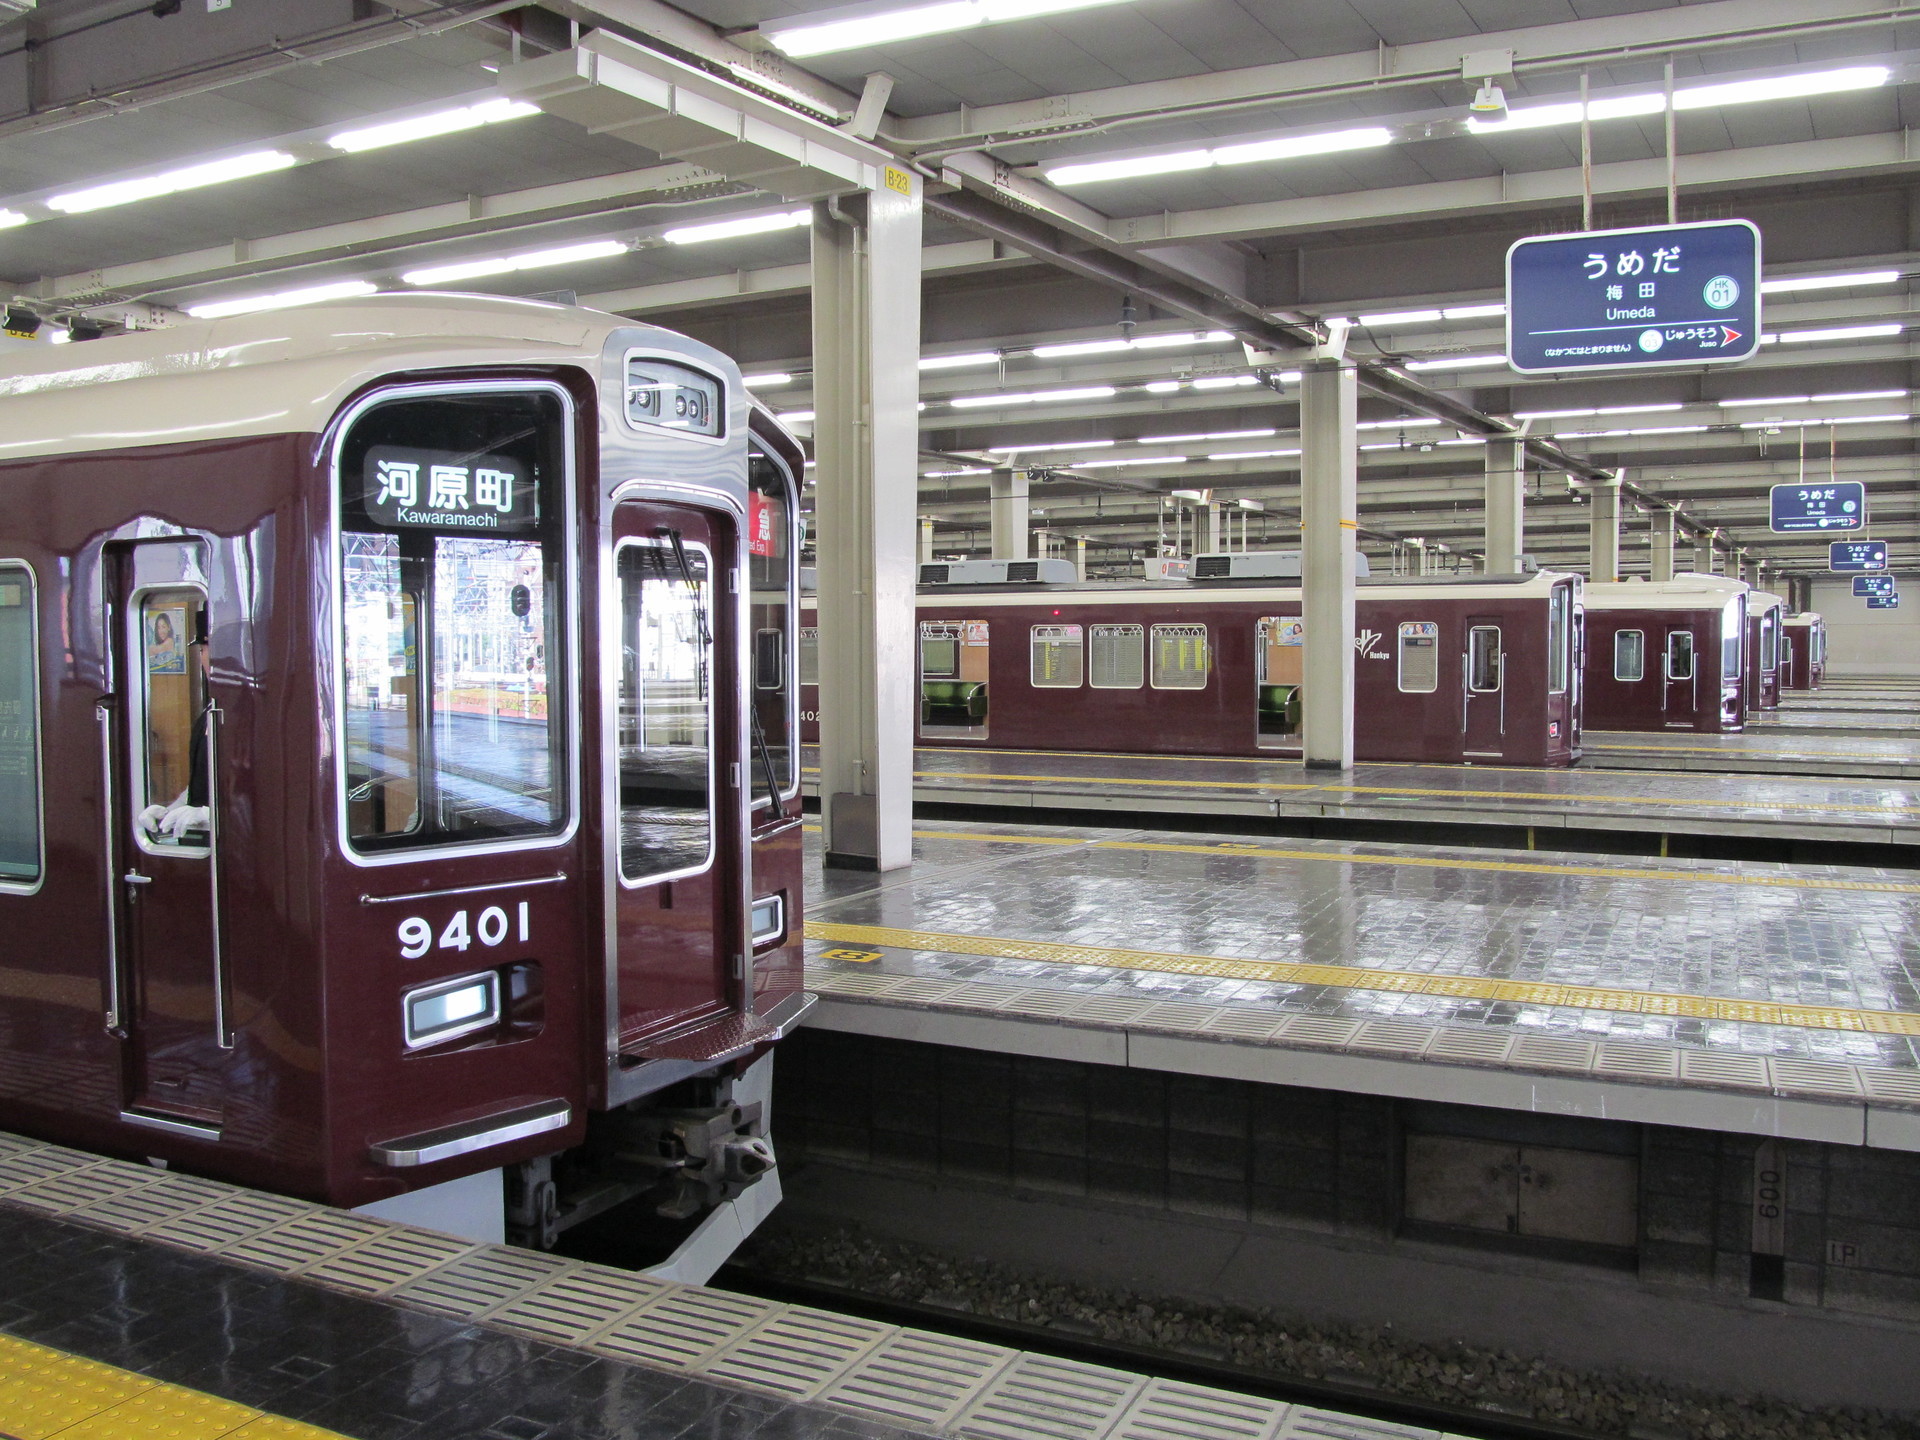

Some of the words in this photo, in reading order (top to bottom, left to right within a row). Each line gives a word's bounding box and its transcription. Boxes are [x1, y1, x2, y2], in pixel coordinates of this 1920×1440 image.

[888, 170, 908, 192] B-23
[1583, 246, 1681, 280] うめだ
[1606, 282, 1655, 301] 梅田
[1714, 280, 1729, 289] HK
[1711, 289, 1730, 303] 01
[1606, 306, 1656, 321] Umeda
[1665, 327, 1717, 341] じゅうそう
[1699, 340, 1717, 348] Juso
[377, 460, 515, 512] 河原町
[1798, 489, 1836, 500] うめだ
[397, 507, 498, 527] Kawaramachi
[398, 901, 529, 959] 9401
